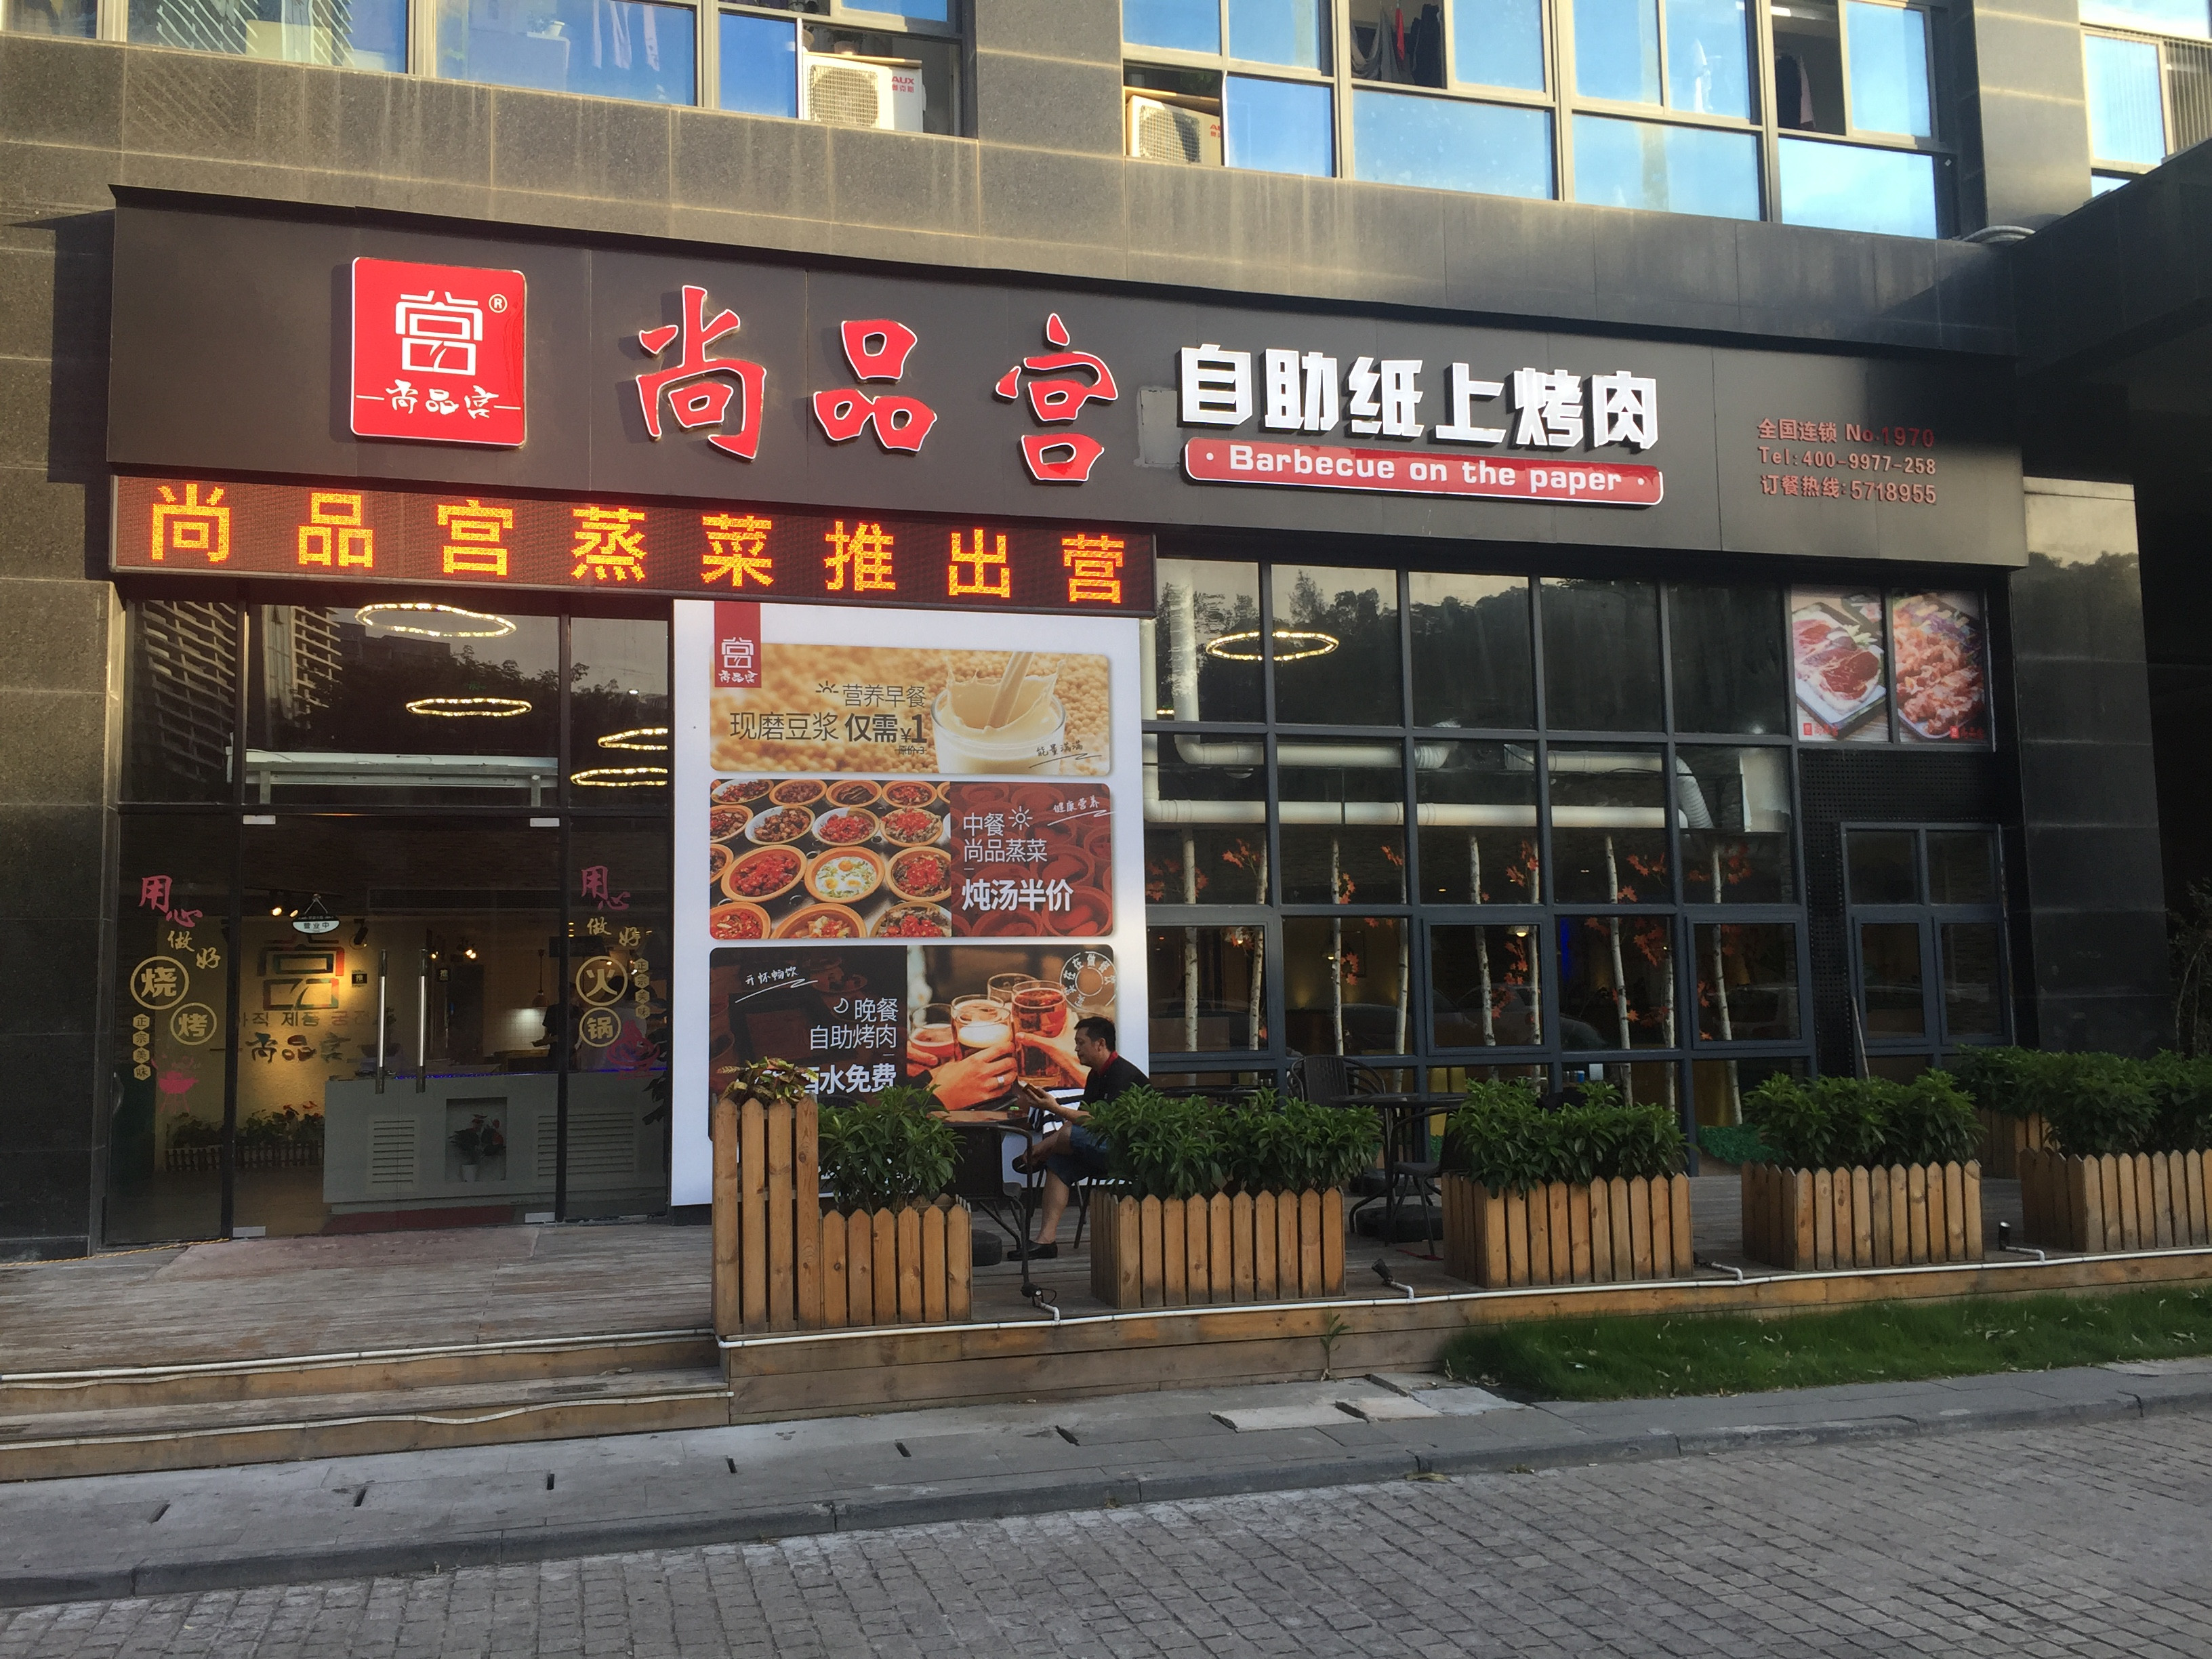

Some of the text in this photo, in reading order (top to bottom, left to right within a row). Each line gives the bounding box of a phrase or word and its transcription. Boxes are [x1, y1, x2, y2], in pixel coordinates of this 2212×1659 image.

[892, 76, 914, 84] AUX
[636, 285, 1118, 483] 尚品宫
[1181, 344, 1658, 450] 自助纸上烤肉
[386, 380, 499, 419] 尚品宫
[1757, 418, 1935, 448] 全国连锁 No.1970
[1229, 445, 1622, 495] Barbecue on the paper
[150, 483, 1126, 605] 尚品宫蒸菜推出营
[842, 684, 926, 708] 营养早餐
[1037, 740, 1083, 757] 能量满满
[1053, 794, 1101, 813] 健康营养
[963, 813, 1005, 837] 中餐
[964, 838, 1048, 863] 尚品蒸菜
[138, 874, 203, 928] 用心
[581, 865, 630, 911] 用心
[962, 878, 1074, 912] 炖汤半价
[745, 966, 798, 985] 开怀畅饮
[855, 997, 899, 1022] 晚餐
[810, 1024, 897, 1050] 自助烤肉
